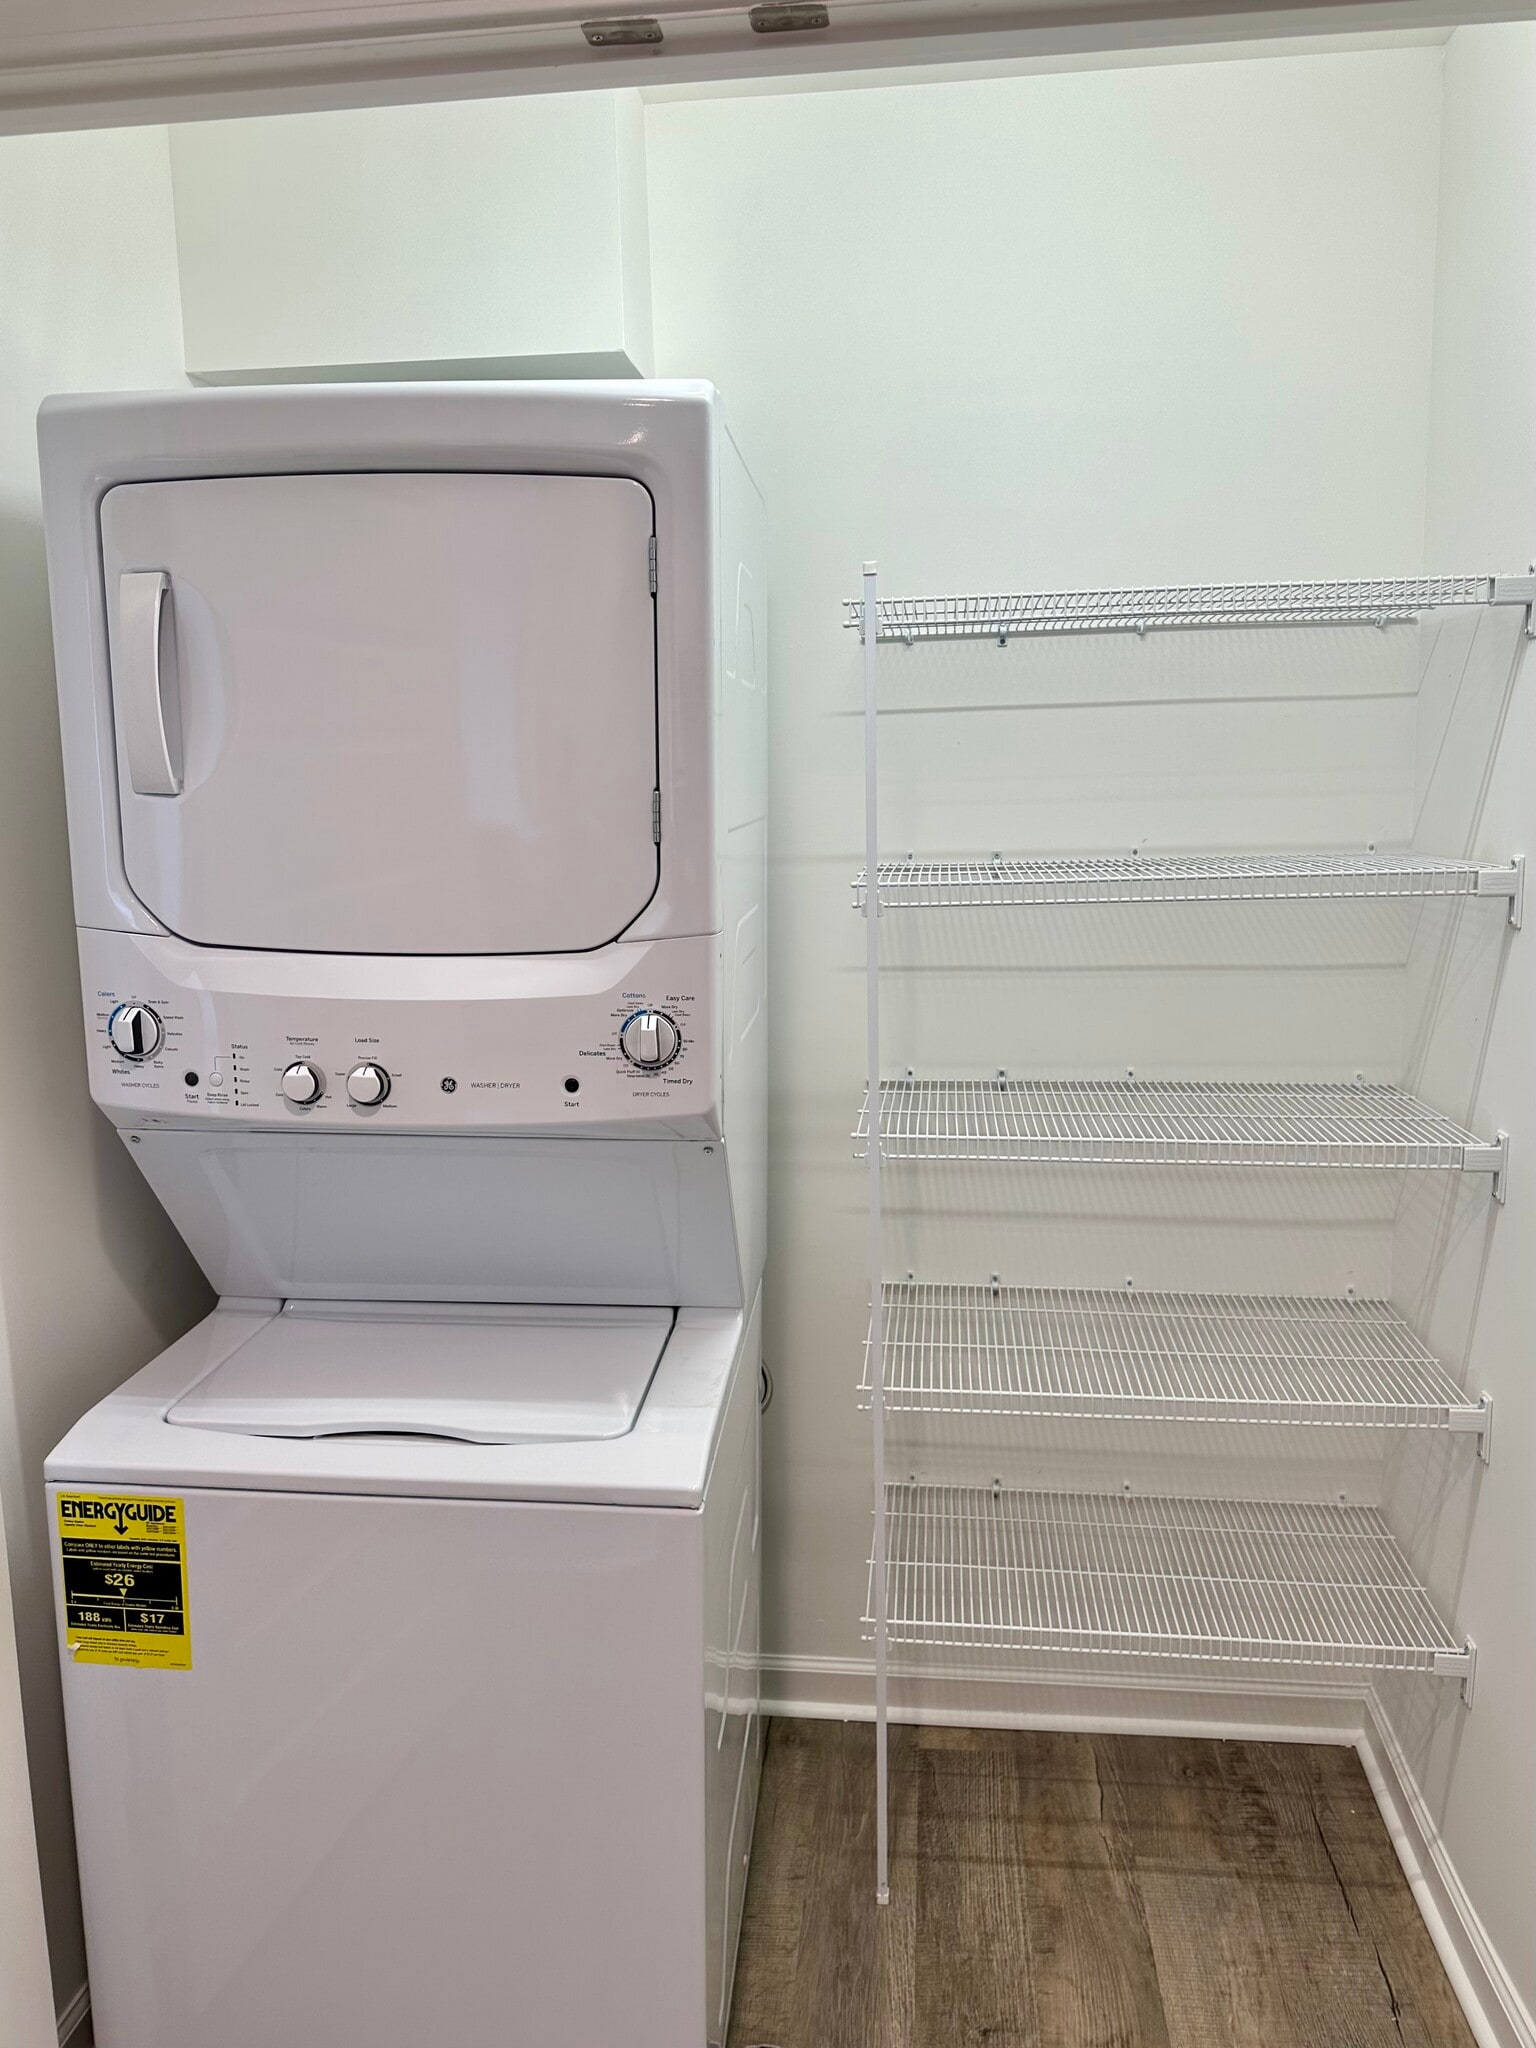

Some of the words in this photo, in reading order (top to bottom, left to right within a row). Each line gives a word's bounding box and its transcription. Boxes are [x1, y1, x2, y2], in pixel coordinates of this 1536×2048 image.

[61, 1500, 177, 1523] ENERGYGUIDE
[104, 1573, 136, 1587] $26
[78, 1611, 101, 1622] 188
[140, 1612, 165, 1624] $17
